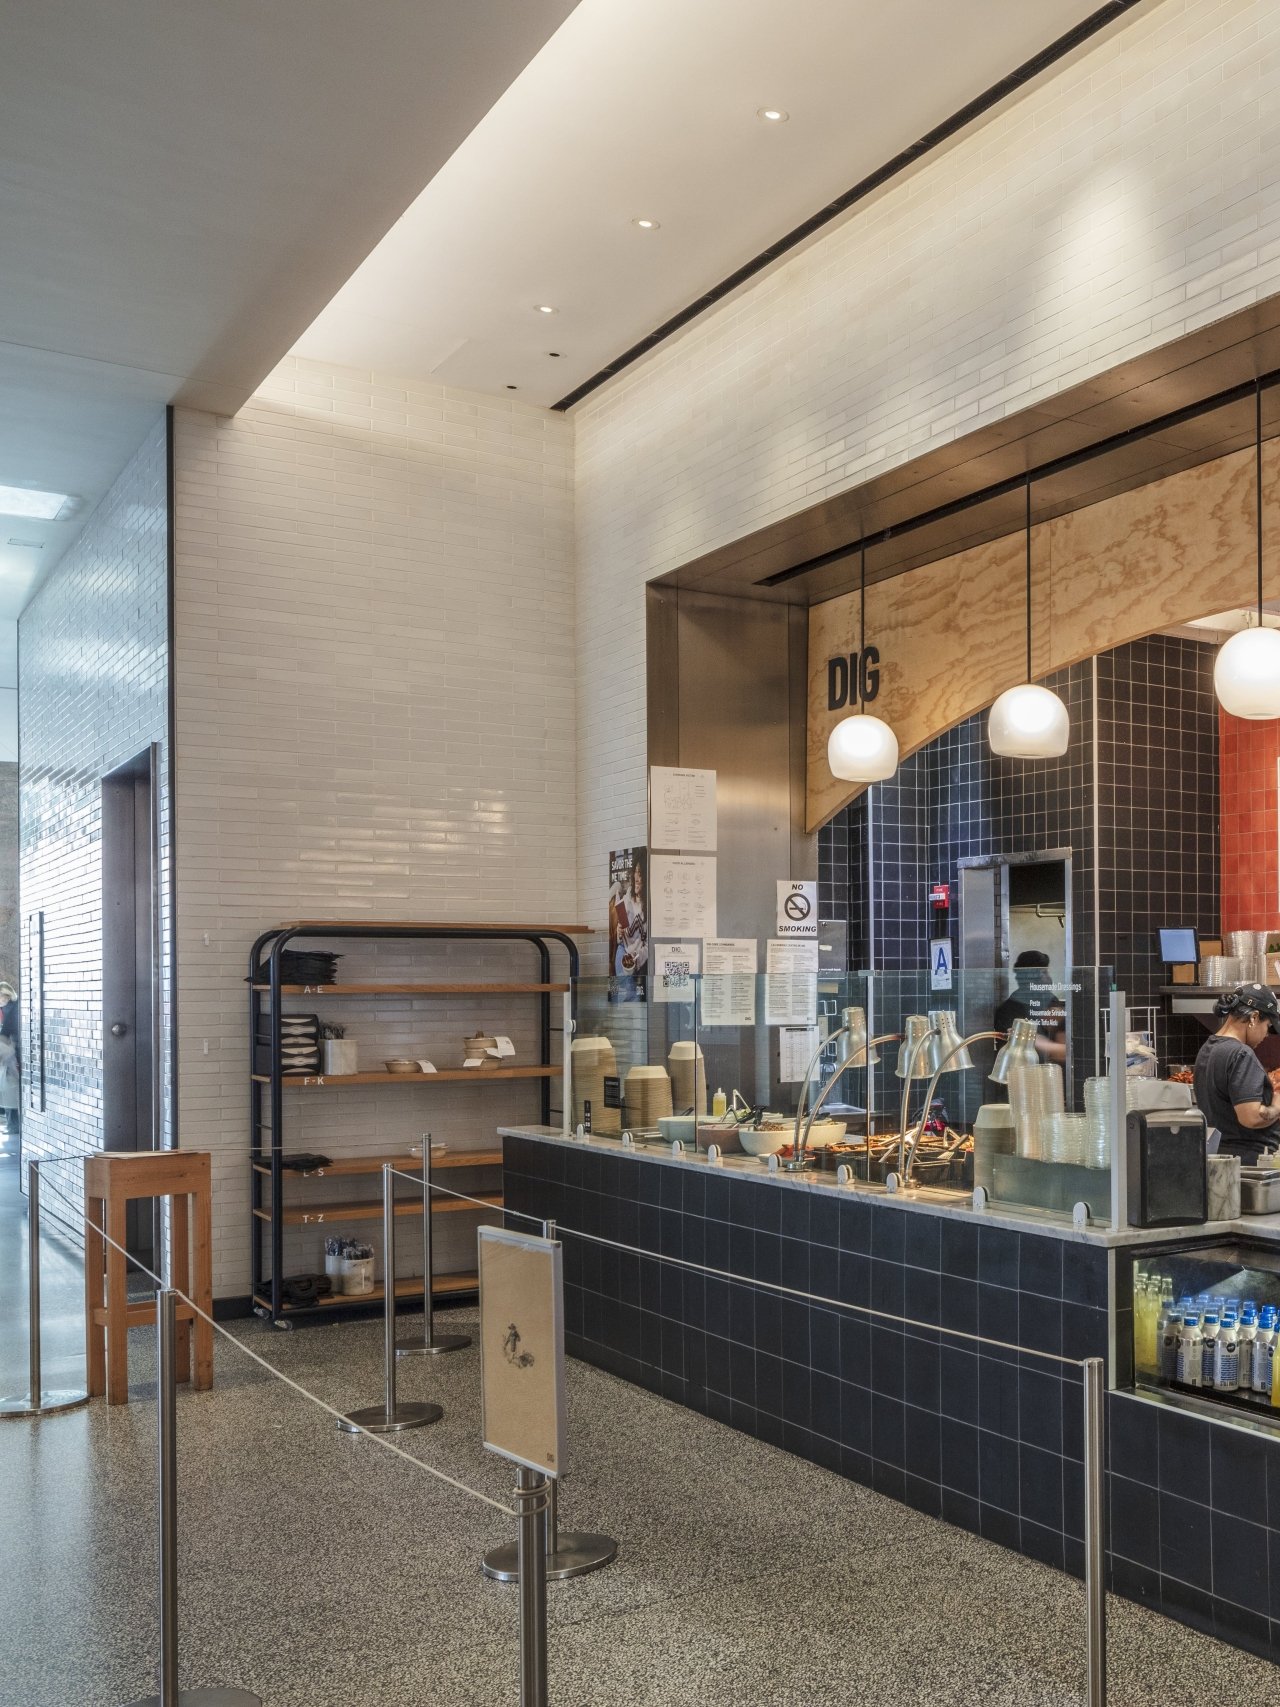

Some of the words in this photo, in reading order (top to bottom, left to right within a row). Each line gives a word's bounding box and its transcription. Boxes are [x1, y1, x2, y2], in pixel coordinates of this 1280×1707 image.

[828, 646, 880, 711] DIG
[791, 883, 804, 891] NO
[778, 925, 817, 933] SMOKING
[934, 947, 948, 976] A
[1029, 982, 1057, 991] Housemade
[1057, 982, 1082, 993] Dressings
